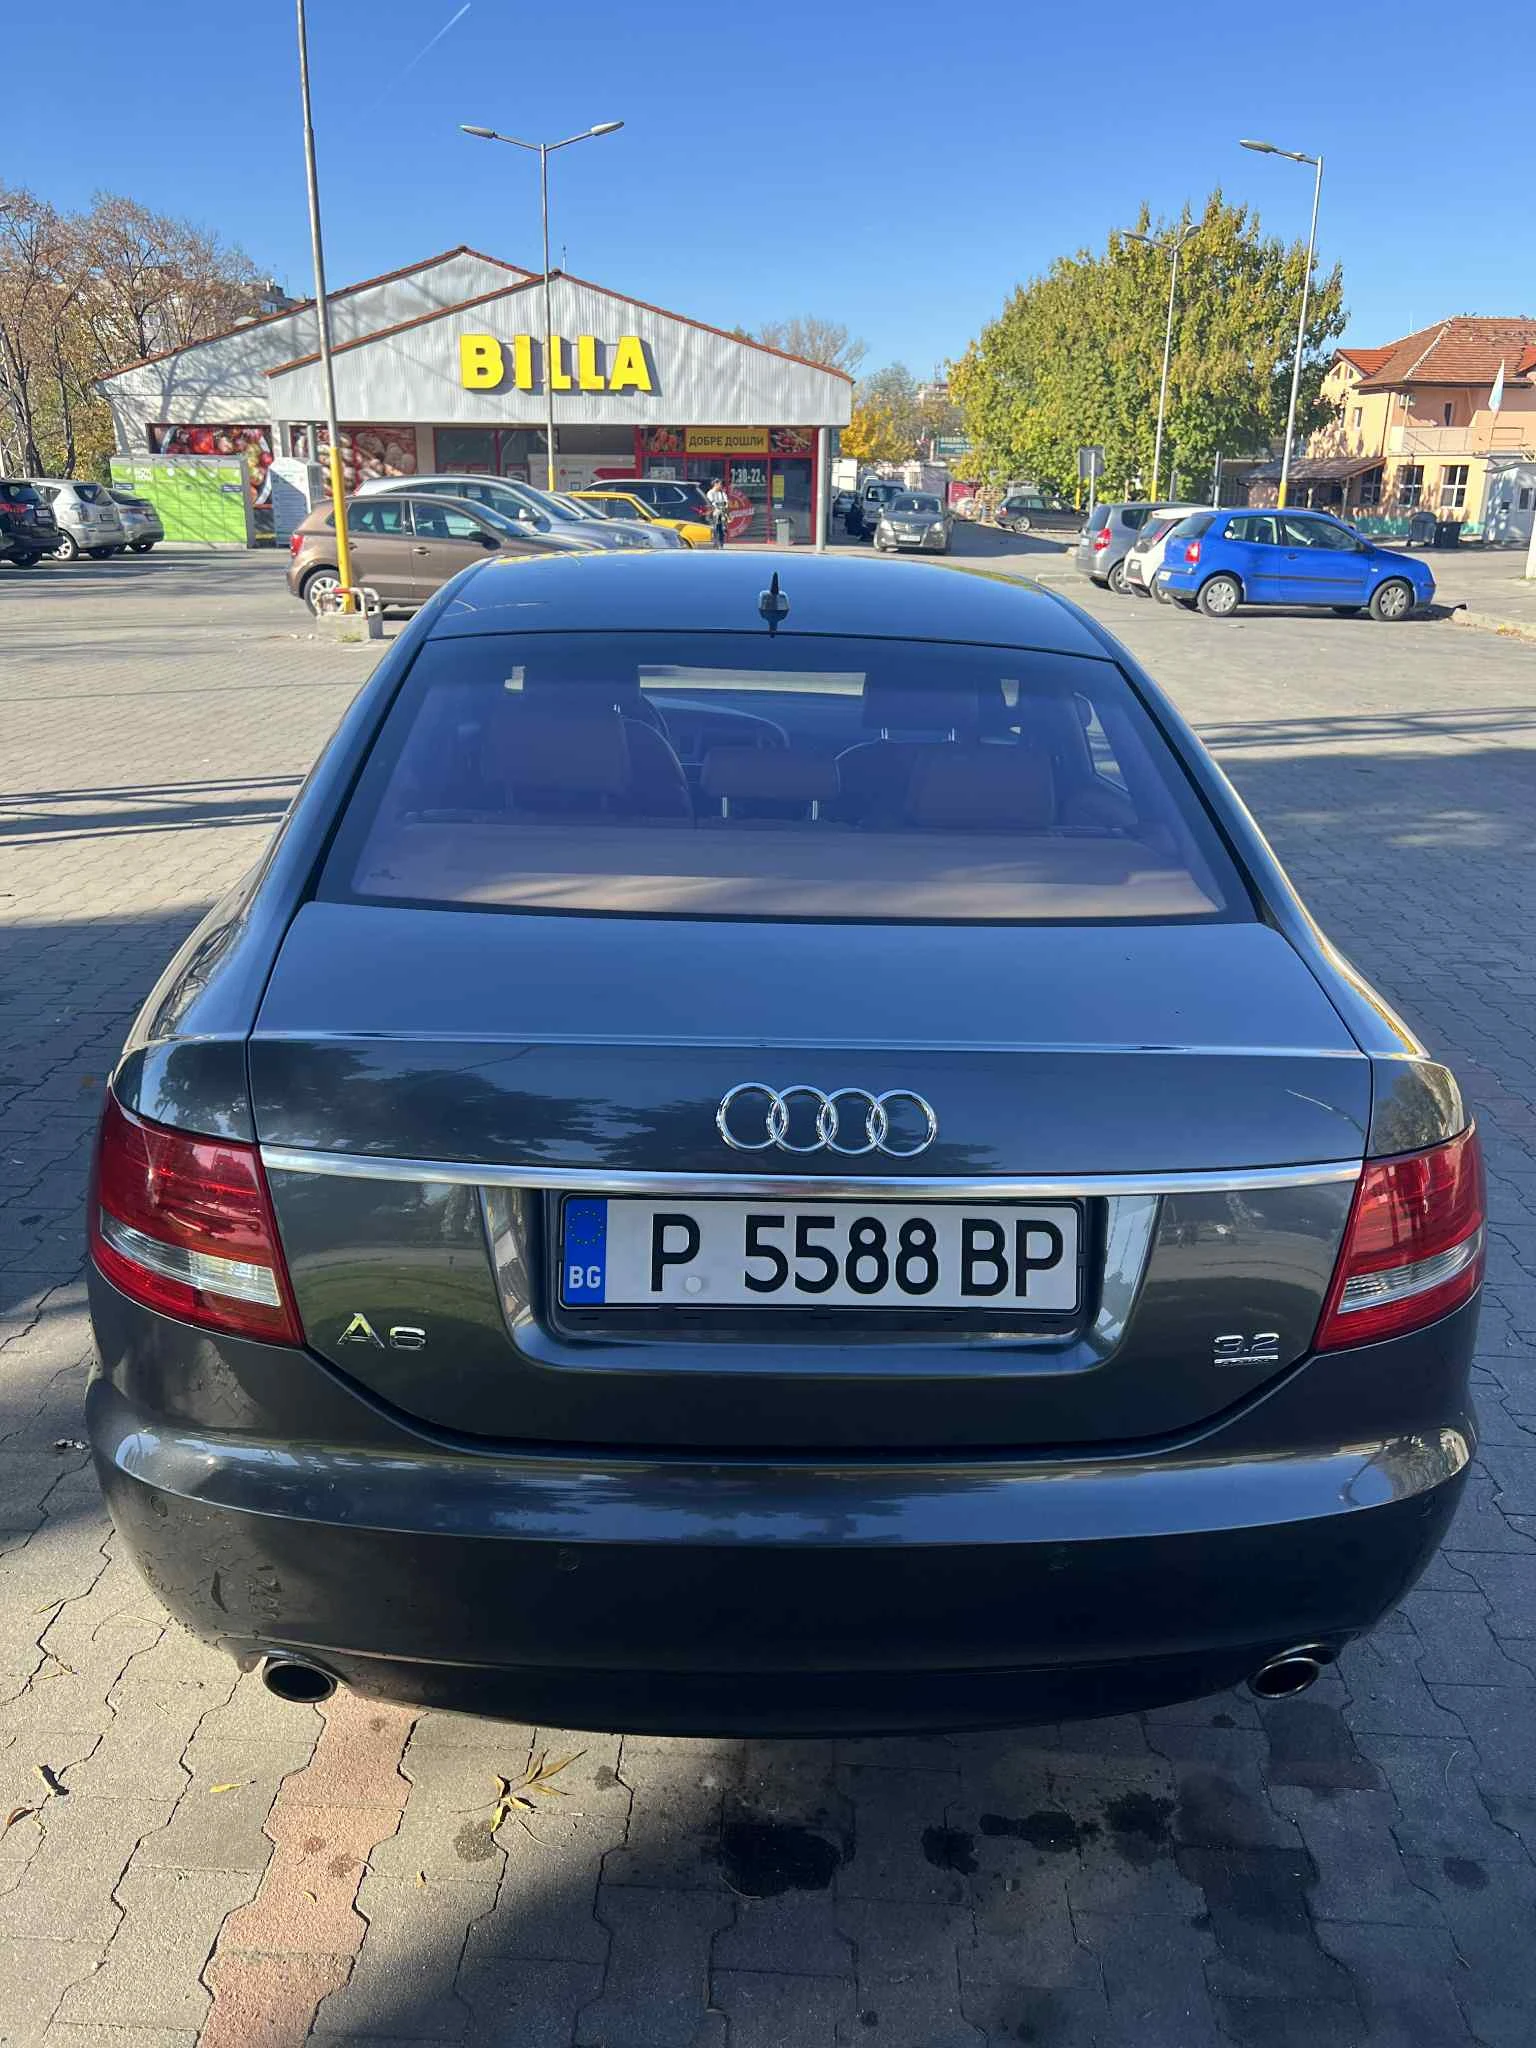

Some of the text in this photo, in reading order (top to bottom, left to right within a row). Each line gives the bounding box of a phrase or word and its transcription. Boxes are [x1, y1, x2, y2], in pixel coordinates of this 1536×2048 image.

[460, 335, 652, 391] BILLA
[689, 435, 764, 448] ДОБРЕ ДОШЛИ
[651, 1213, 1064, 1297] P 5588 BP
[569, 1266, 601, 1289] BG
[337, 1312, 427, 1350] A6
[1213, 1333, 1280, 1354] 3.2
